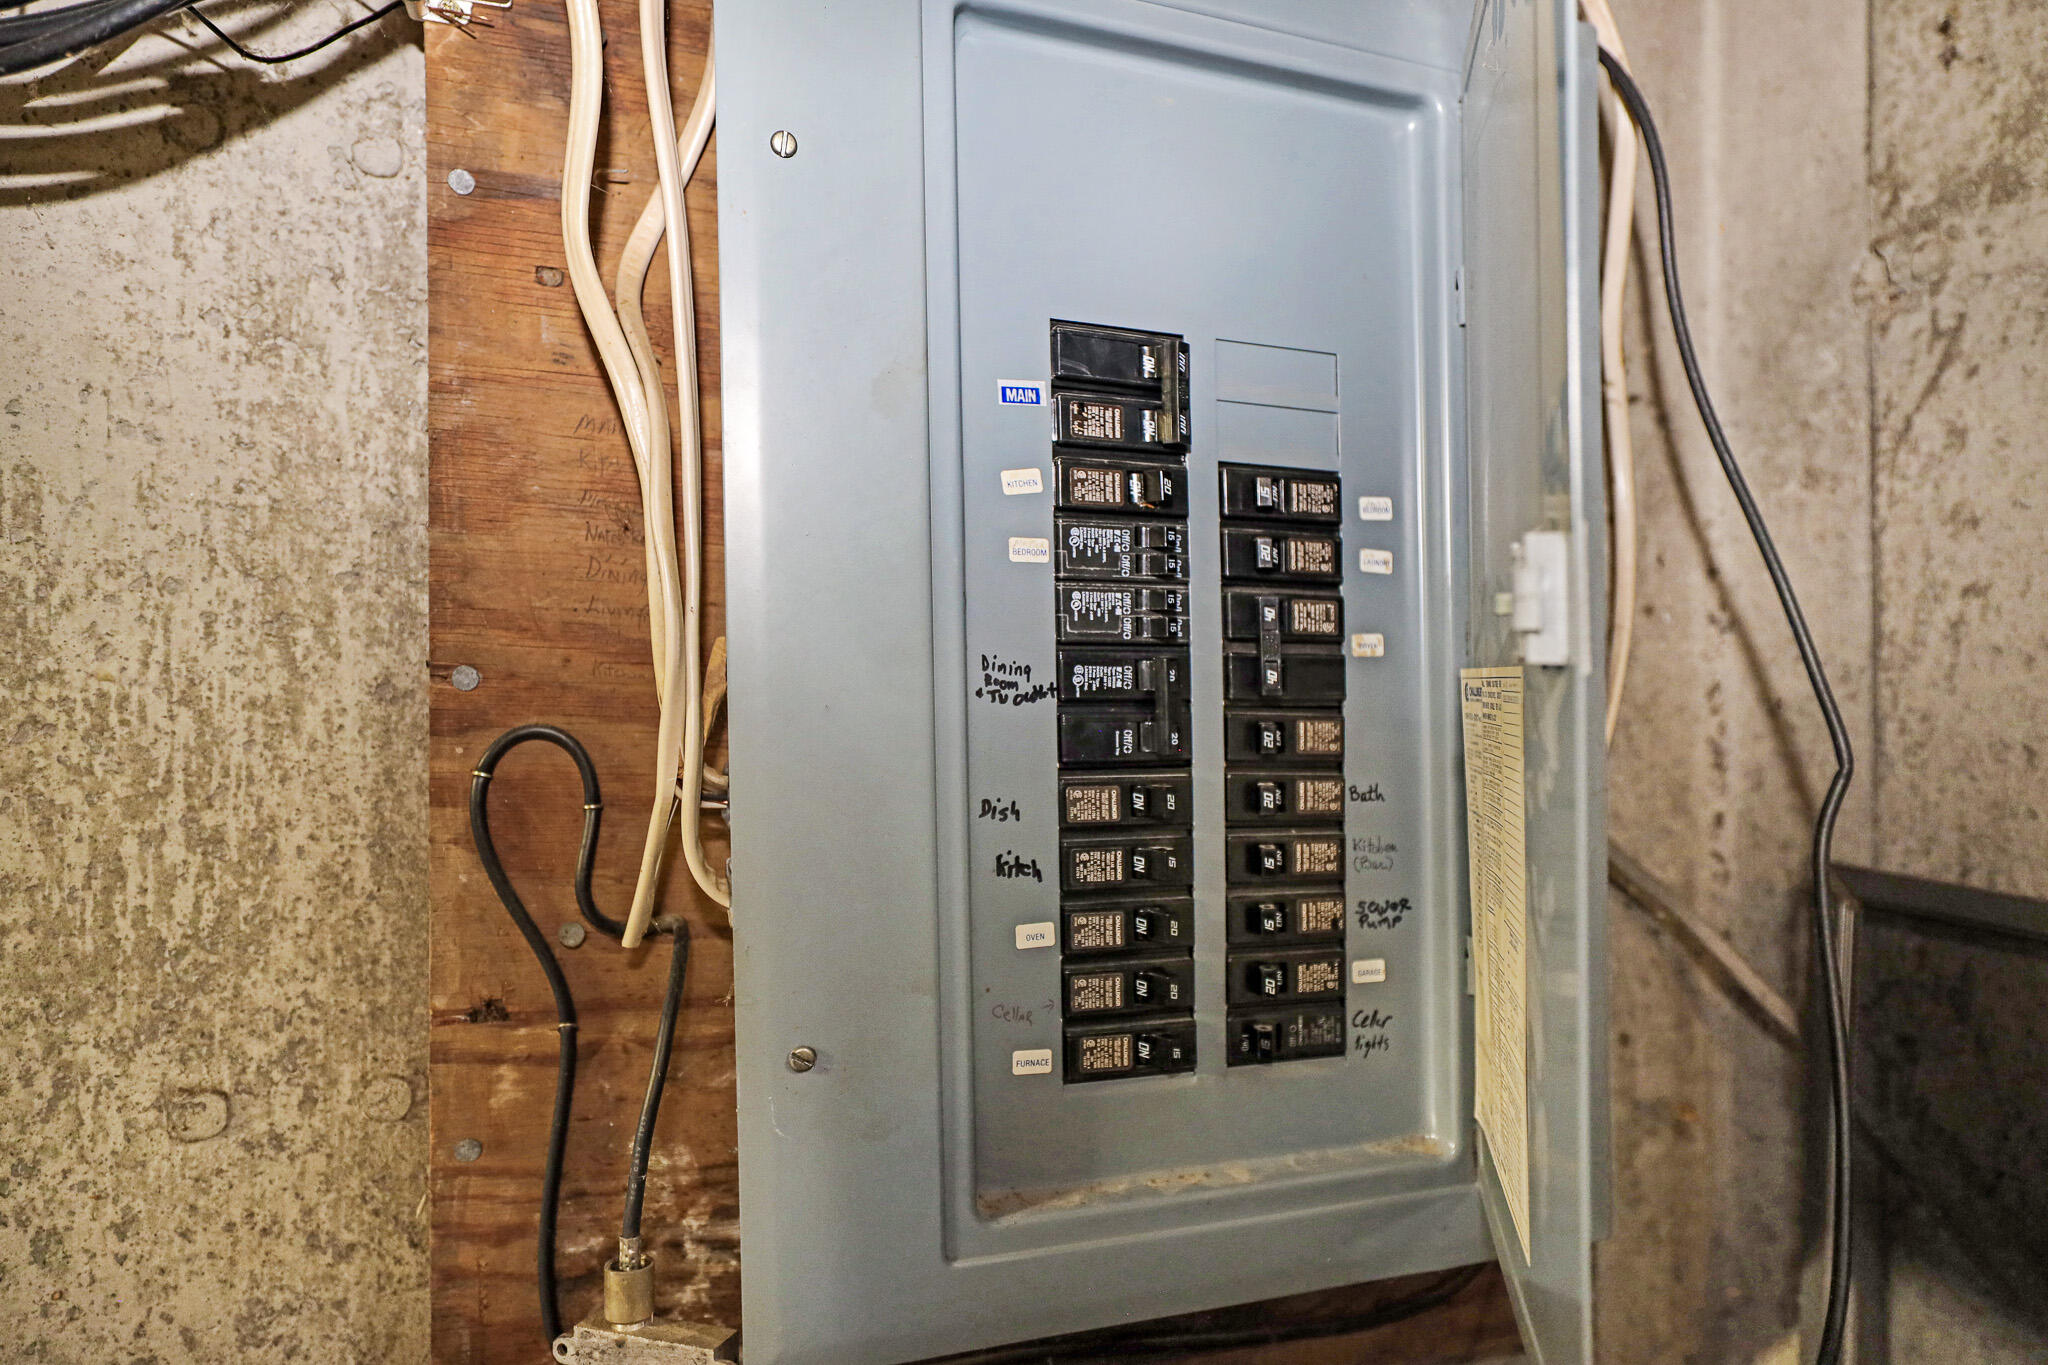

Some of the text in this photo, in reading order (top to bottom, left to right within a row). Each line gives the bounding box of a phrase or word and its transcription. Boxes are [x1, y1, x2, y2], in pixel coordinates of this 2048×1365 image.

[1005, 388, 1036, 403] MAIN
[1007, 479, 1038, 489] KITCHEN
[1164, 479, 1172, 495] 20
[1261, 486, 1270, 498] 15
[1167, 531, 1175, 541] 15
[1012, 548, 1048, 557] BEDROOM
[1261, 545, 1270, 562] 20
[1168, 559, 1176, 569] 15
[1167, 594, 1175, 604] 15
[1169, 623, 1177, 633] 15
[981, 654, 1032, 683] Dining
[984, 673, 1019, 691] Room
[987, 690, 1009, 705] TV
[1171, 732, 1178, 745] 20
[1264, 732, 1273, 748] 20
[1264, 792, 1273, 809] 20
[1349, 783, 1385, 802] Bath
[1132, 792, 1145, 810] ON
[1167, 794, 1175, 810] 20
[978, 798, 1020, 822] Dish
[995, 851, 1043, 883] Kitch
[1133, 856, 1145, 873] ON
[1169, 857, 1176, 868] 15
[1265, 857, 1275, 869] 15
[1135, 917, 1147, 935] ON
[1170, 920, 1178, 936] 20
[1264, 919, 1274, 931] 15
[1026, 933, 1045, 942] OVEN
[1136, 979, 1148, 997] ON
[1170, 984, 1178, 1000] 20
[1265, 978, 1275, 995] 20
[1137, 1041, 1150, 1059] ON
[1173, 1048, 1181, 1059] 15
[1016, 1059, 1049, 1068] FURNACE
